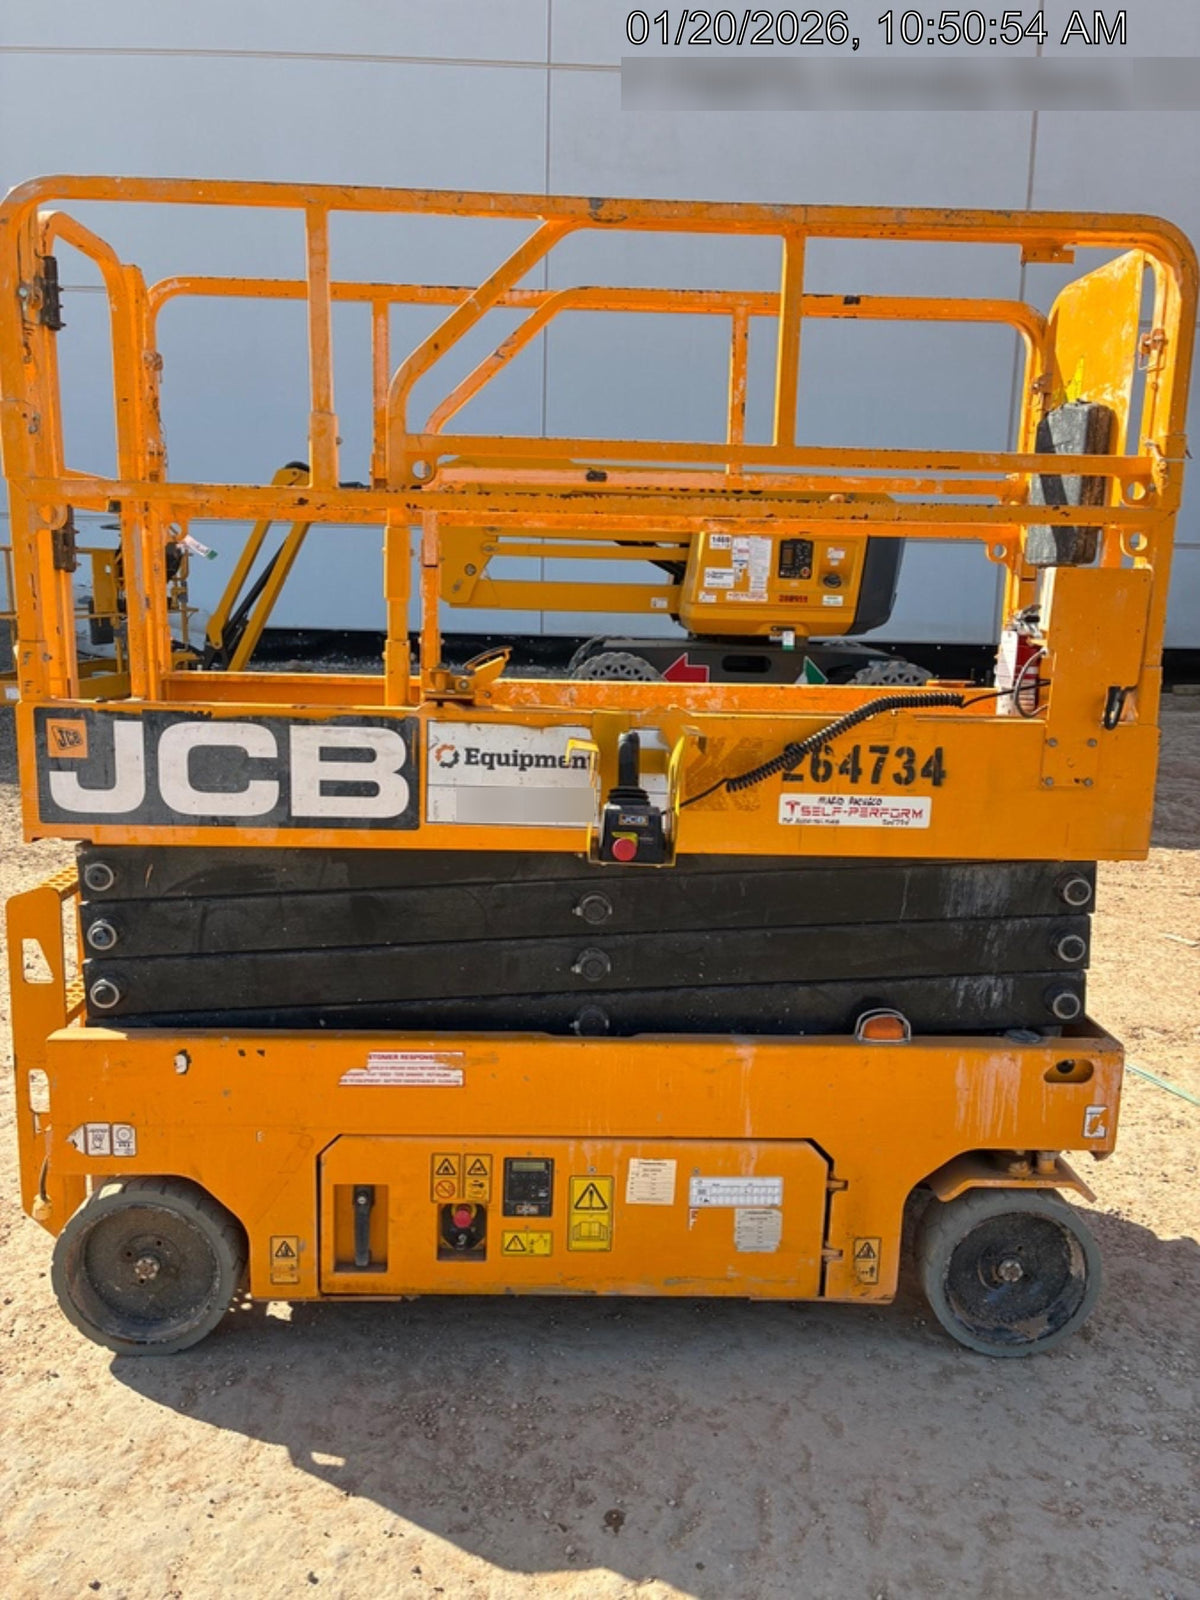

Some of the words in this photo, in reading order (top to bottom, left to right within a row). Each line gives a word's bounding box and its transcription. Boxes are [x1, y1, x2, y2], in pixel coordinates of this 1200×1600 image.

[57, 728, 82, 748] JCB
[49, 719, 410, 819] JCB
[464, 748, 591, 772] Equipmen
[800, 805, 924, 819] SELF-PERFORM
